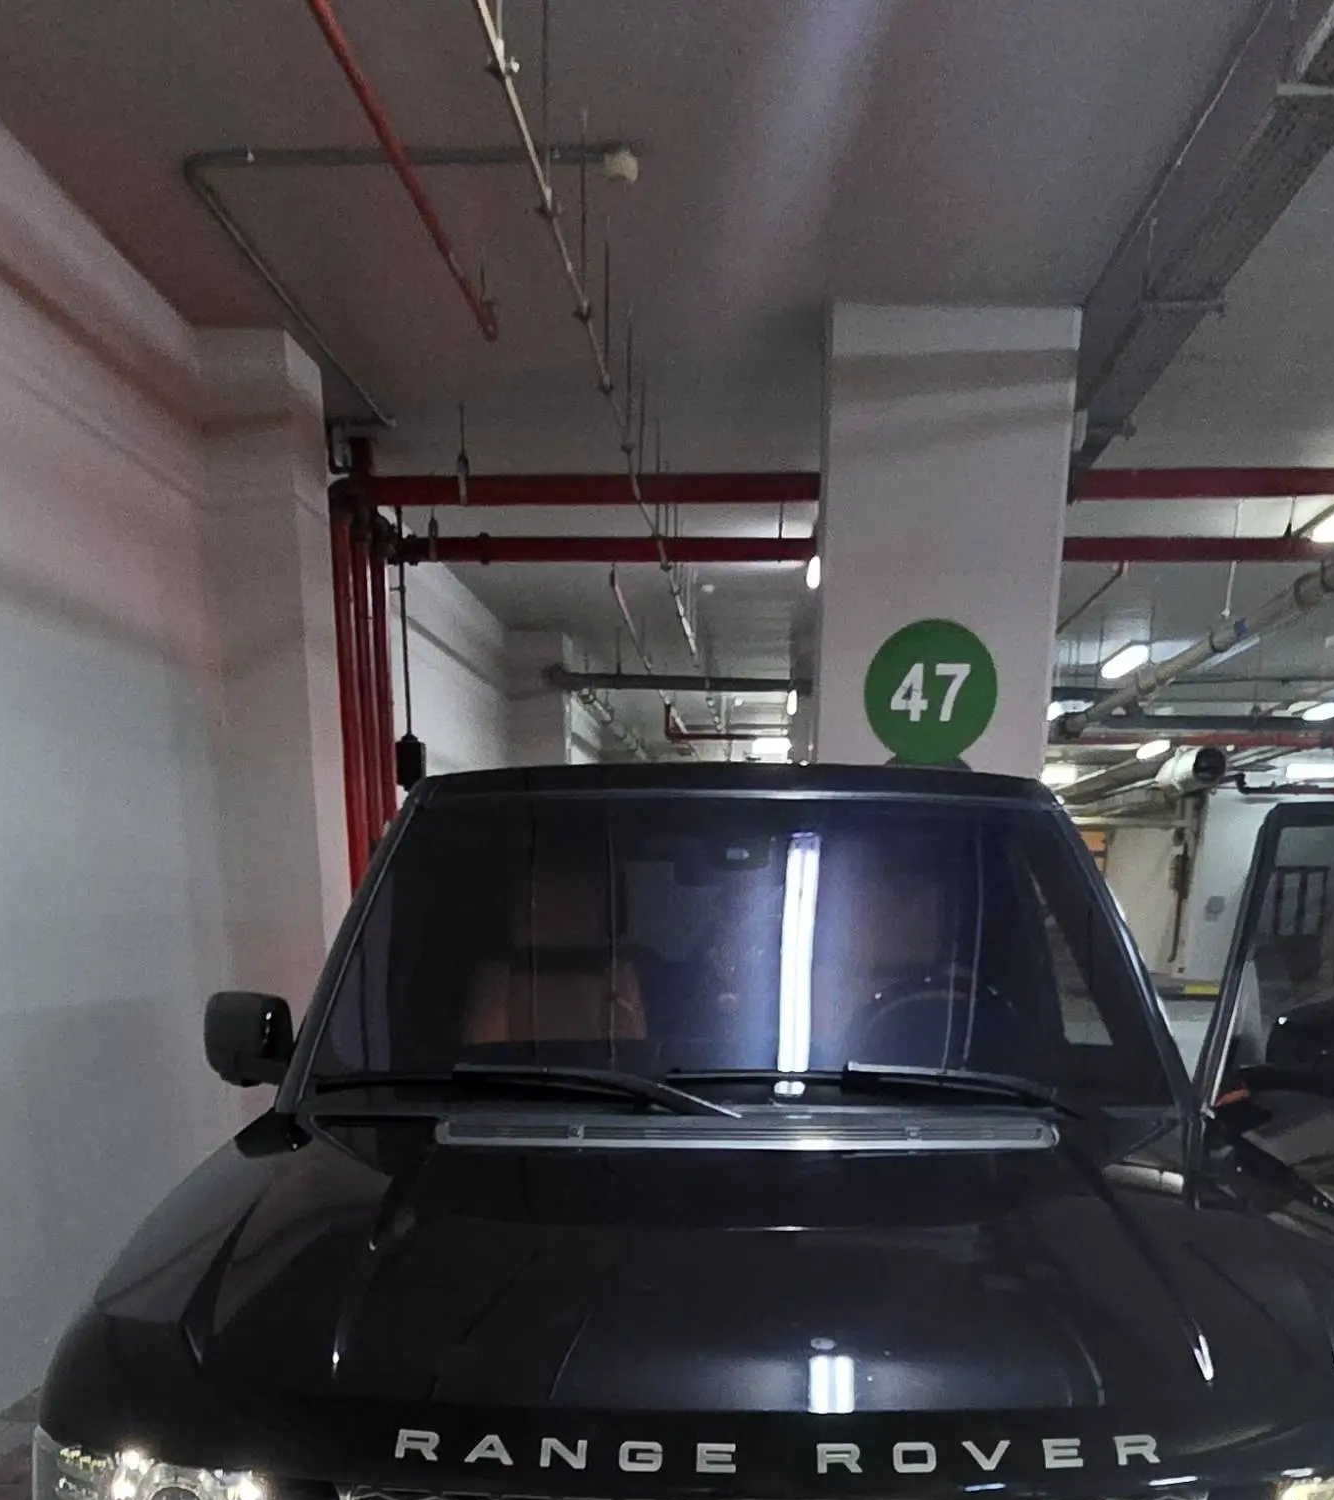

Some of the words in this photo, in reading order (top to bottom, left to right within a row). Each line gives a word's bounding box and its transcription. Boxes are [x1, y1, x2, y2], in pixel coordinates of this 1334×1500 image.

[890, 663, 971, 722] 47
[393, 1428, 737, 1474] RANGE
[816, 1433, 1161, 1474] ROVER
